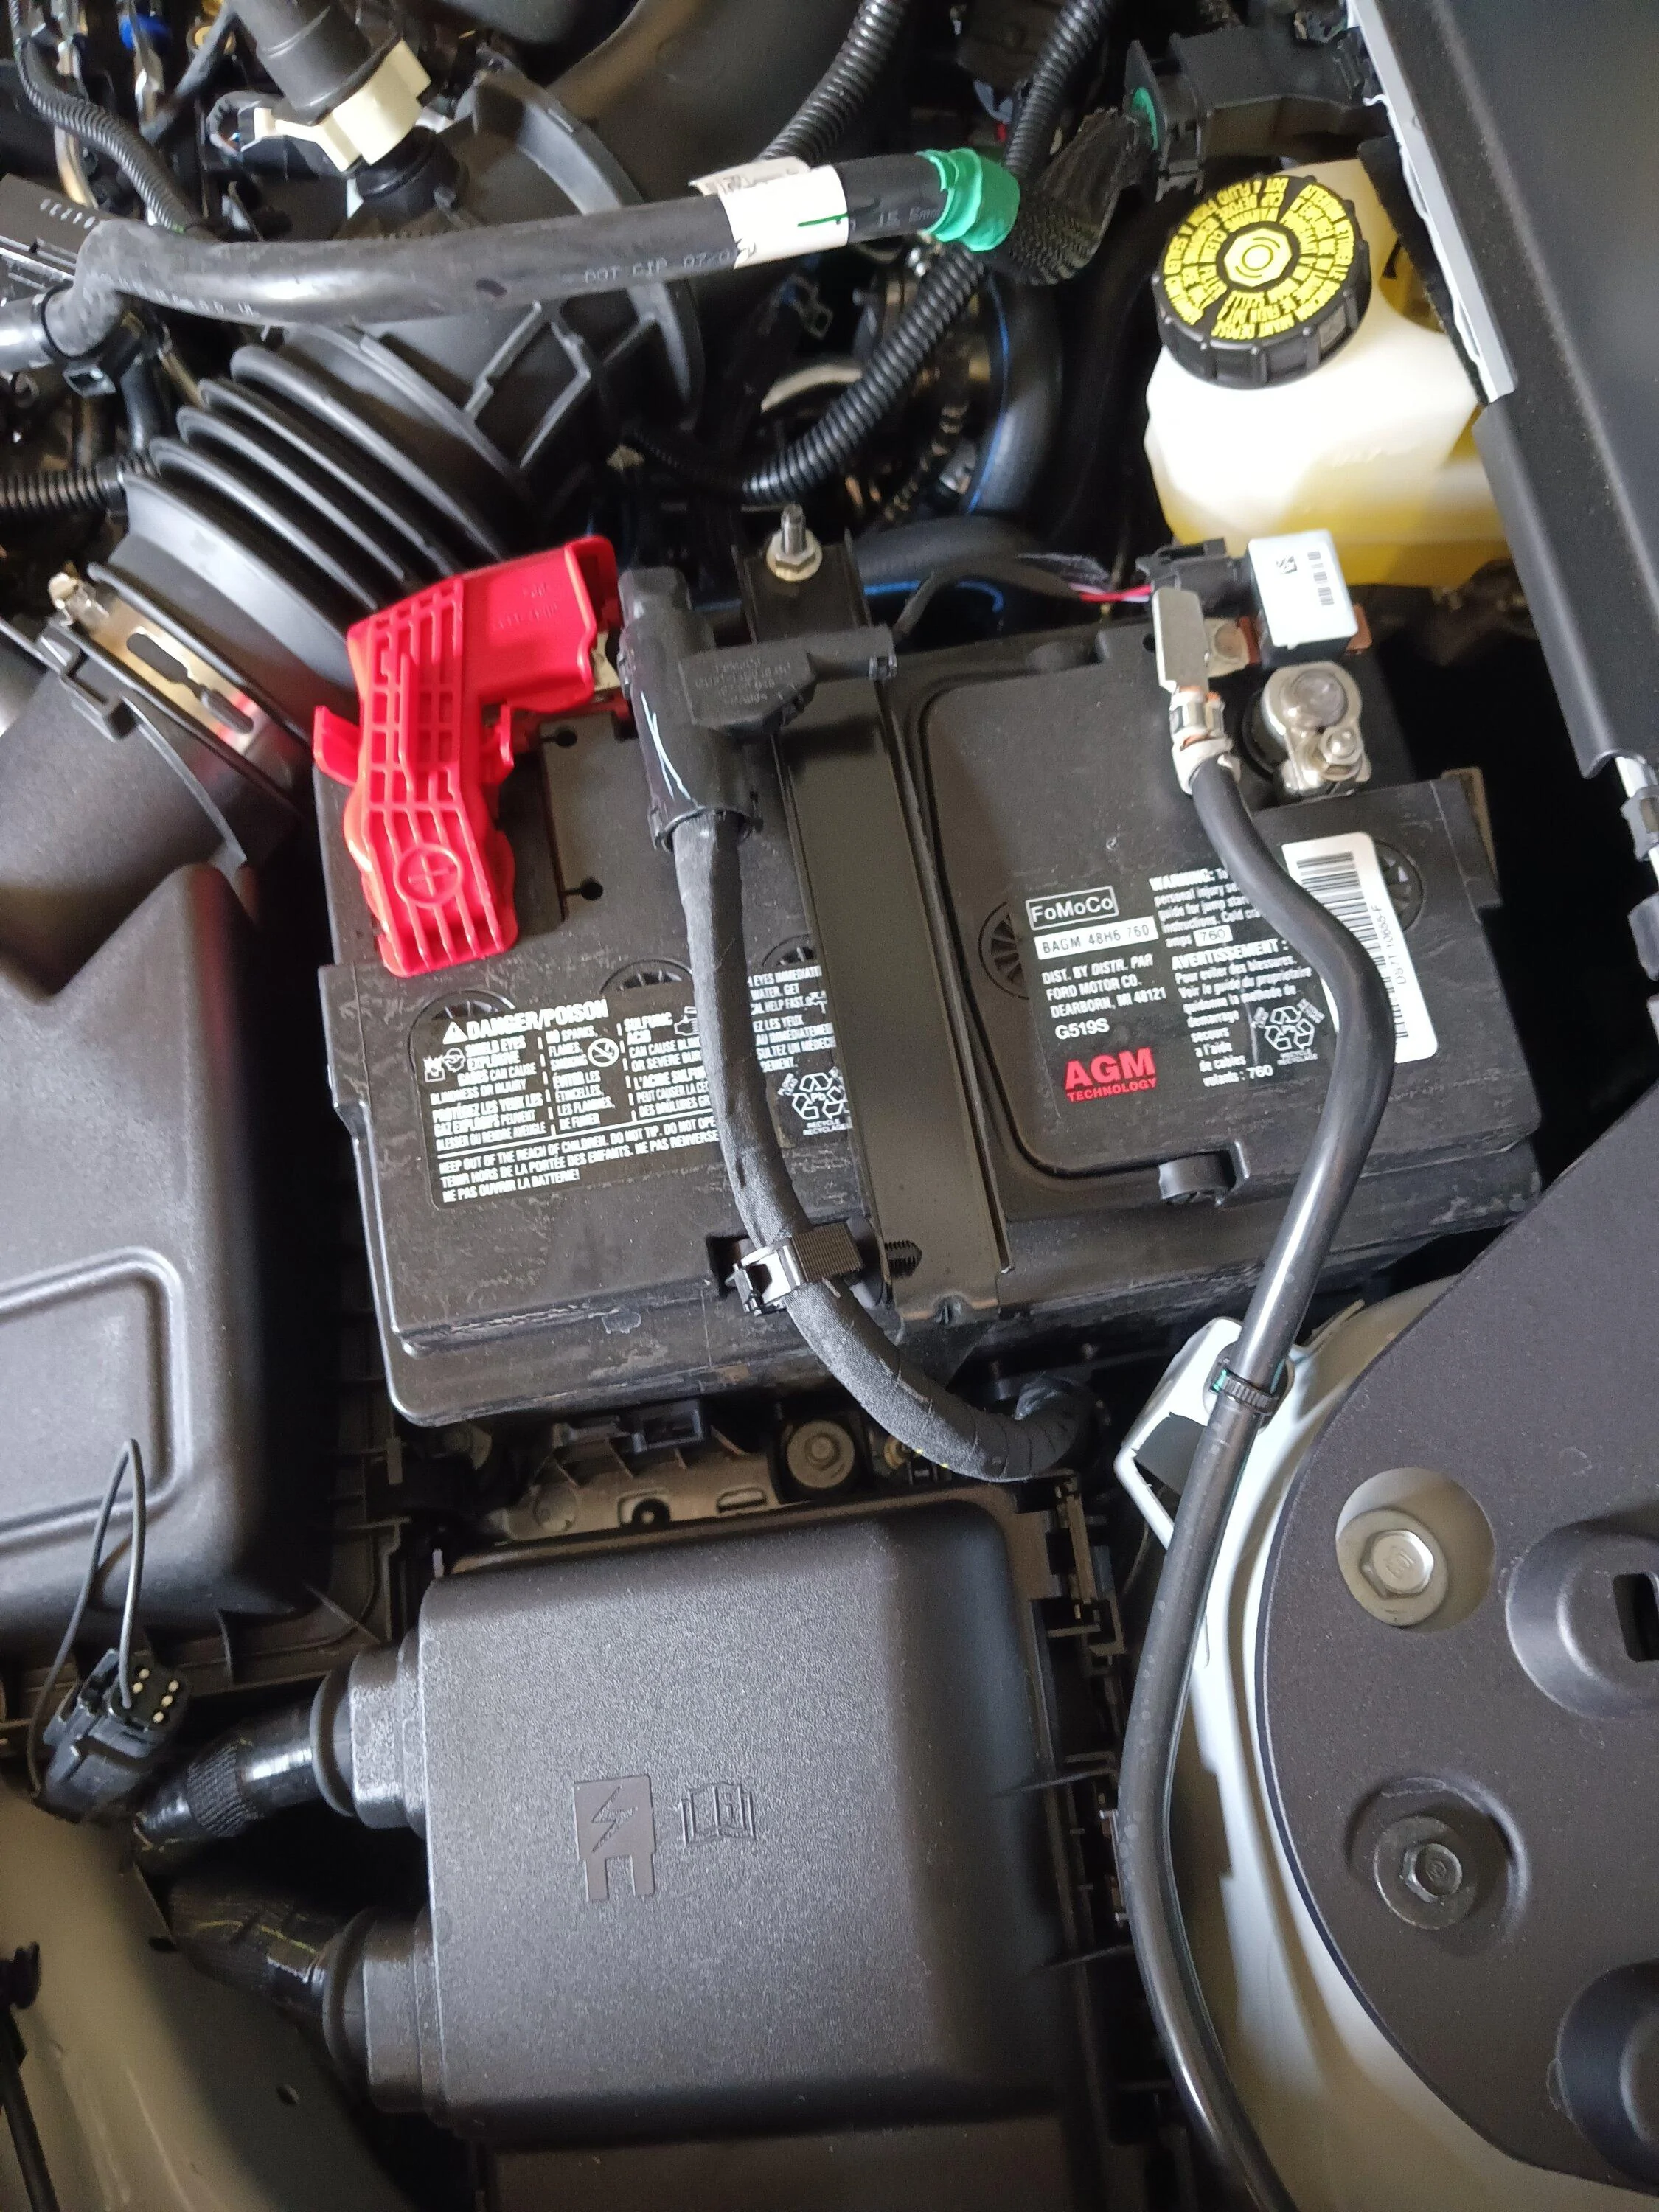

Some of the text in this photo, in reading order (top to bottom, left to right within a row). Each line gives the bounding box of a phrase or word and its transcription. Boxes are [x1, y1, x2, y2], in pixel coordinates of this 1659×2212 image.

[1030, 895, 1114, 922] FoMoCo
[1042, 924, 1150, 954] BAGM 48H6 760
[1200, 928, 1225, 942] 760
[1172, 937, 1279, 970] AVERTISSEMENT
[1072, 964, 1088, 979] BY
[1046, 984, 1078, 1001] FORD
[1078, 977, 1121, 995] MOTOR
[1116, 992, 1133, 1007] MI
[1133, 986, 1166, 1004] 48121
[764, 999, 785, 1012] HELP
[466, 998, 609, 1041] DANGER/POISON
[764, 1017, 782, 1031] LES
[1054, 1018, 1110, 1040] G519S
[647, 1040, 677, 1056] CAUSE
[1064, 1047, 1156, 1091] AGM
[1245, 1064, 1273, 1079] 760
[685, 1082, 698, 1096] LA
[1067, 1077, 1157, 1102] TECHNOLOGY
[439, 1159, 462, 1175] KEEP
[462, 1155, 482, 1171] OUT
[483, 1153, 496, 1167] OF
[496, 1150, 516, 1164] THE
[515, 1144, 547, 1161] REACH
[547, 1142, 560, 1156] OF
[609, 1131, 625, 1145] DO
[624, 1127, 644, 1142] NOT
[663, 1121, 678, 1135] DO
[678, 1119, 697, 1133] NOT
[470, 1167, 499, 1183] HORS
[499, 1164, 514, 1179] DE
[514, 1162, 529, 1176] LA
[566, 1152, 587, 1167] DES
[634, 1141, 650, 1155] NE
[649, 1138, 669, 1152] PAS
[442, 1189, 457, 1203] NE
[457, 1185, 478, 1200] PAS
[516, 1176, 532, 1190] LA
